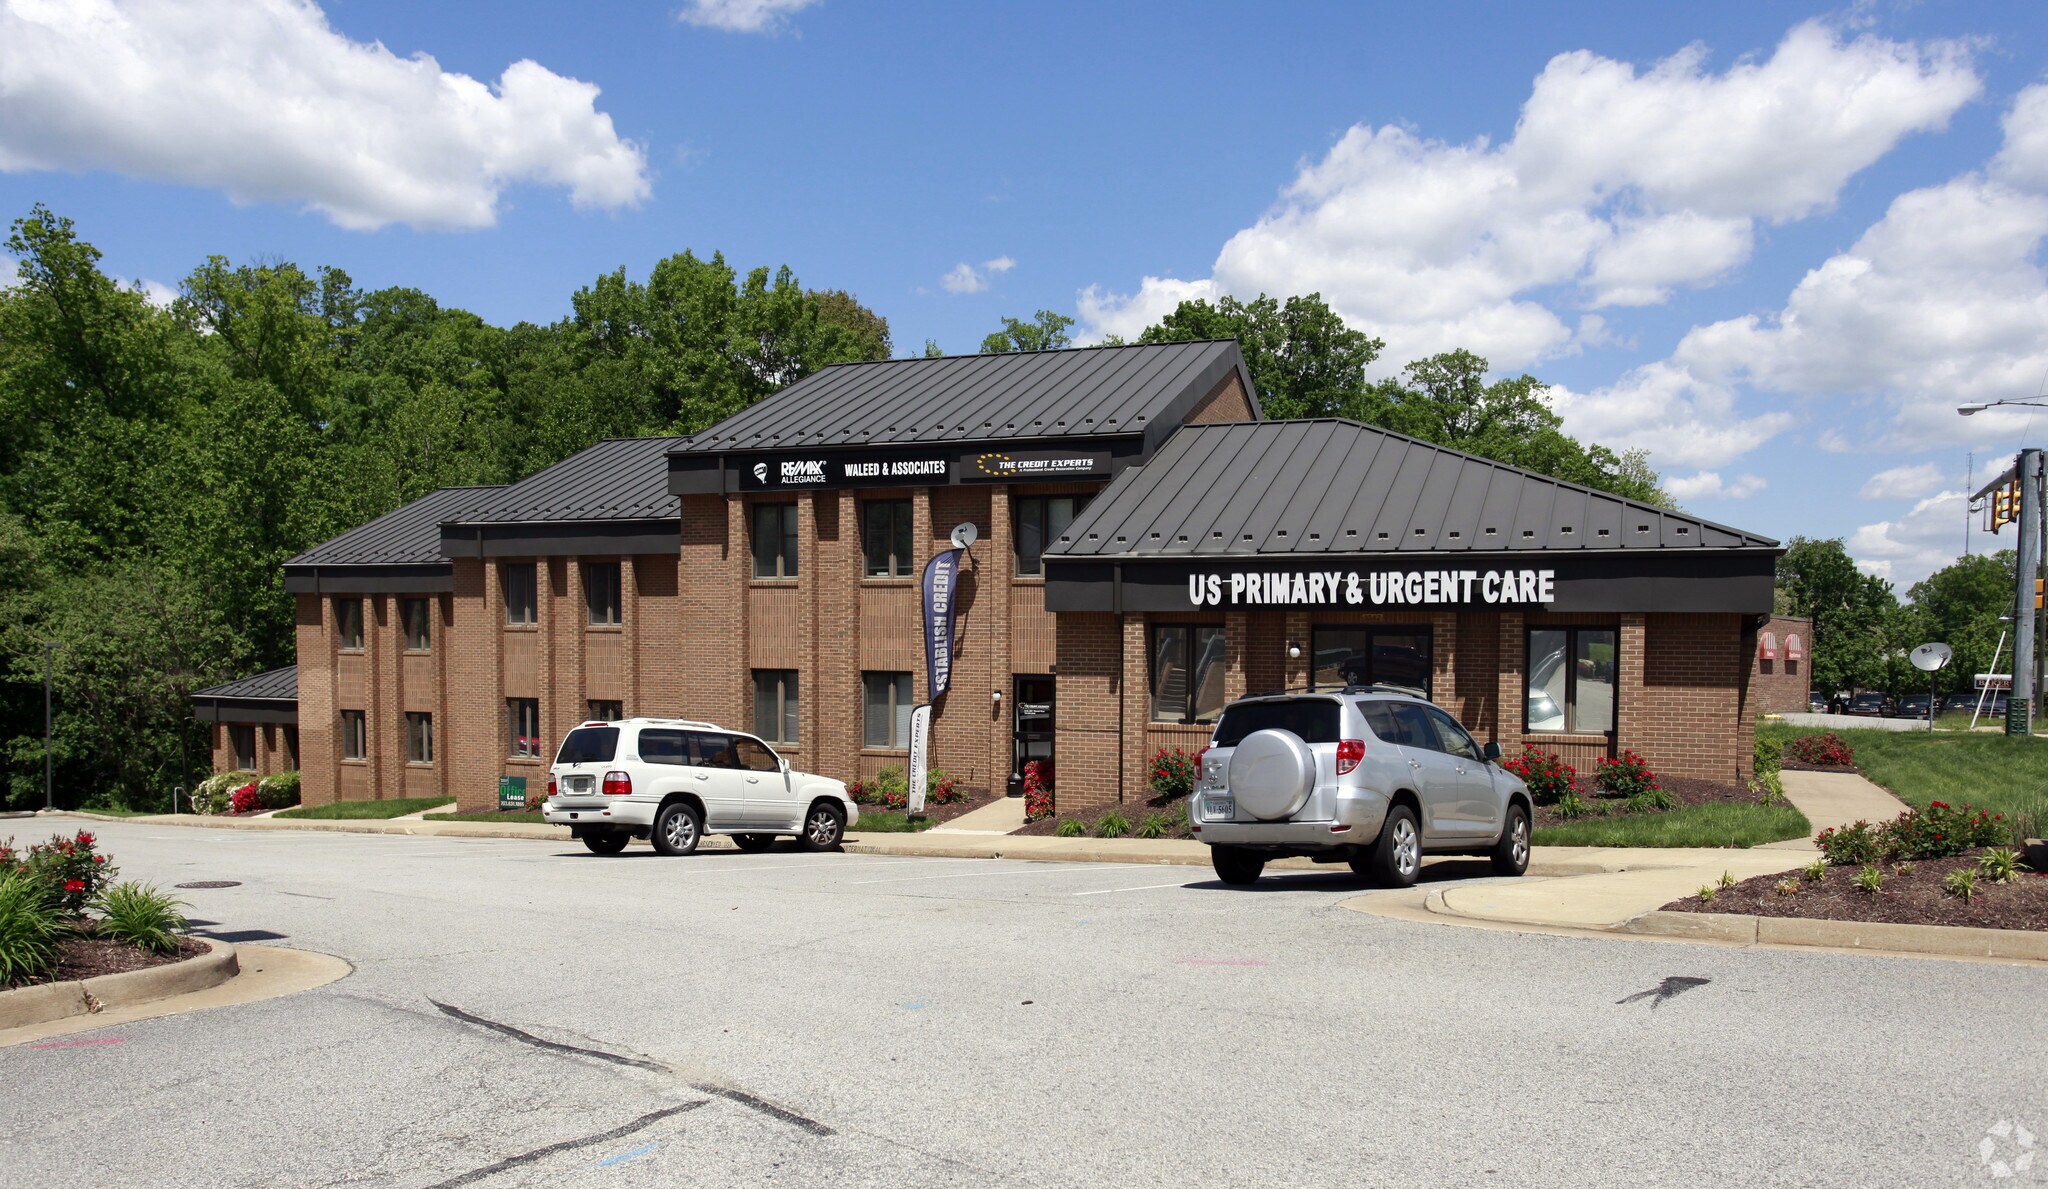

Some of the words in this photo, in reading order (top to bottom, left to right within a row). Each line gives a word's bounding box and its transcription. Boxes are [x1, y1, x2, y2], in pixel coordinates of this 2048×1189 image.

[781, 461, 824, 476] RE/MAX
[845, 463, 880, 477] WALEED
[882, 463, 889, 476] &
[891, 460, 946, 476] ASSOCIATES
[1017, 461, 1050, 469] CREDIT
[1051, 459, 1094, 467] EXPERTS
[781, 475, 826, 484] ALLEGIANCE
[933, 560, 951, 613] CREDIT
[1188, 573, 1222, 606] US
[1230, 571, 1342, 604] PRIMARY
[1345, 571, 1363, 605] &
[1369, 570, 1477, 604] URGENT
[1482, 569, 1555, 604] CARE
[934, 616, 949, 692] ESTABLISH
[1978, 680, 2012, 688] BKER
